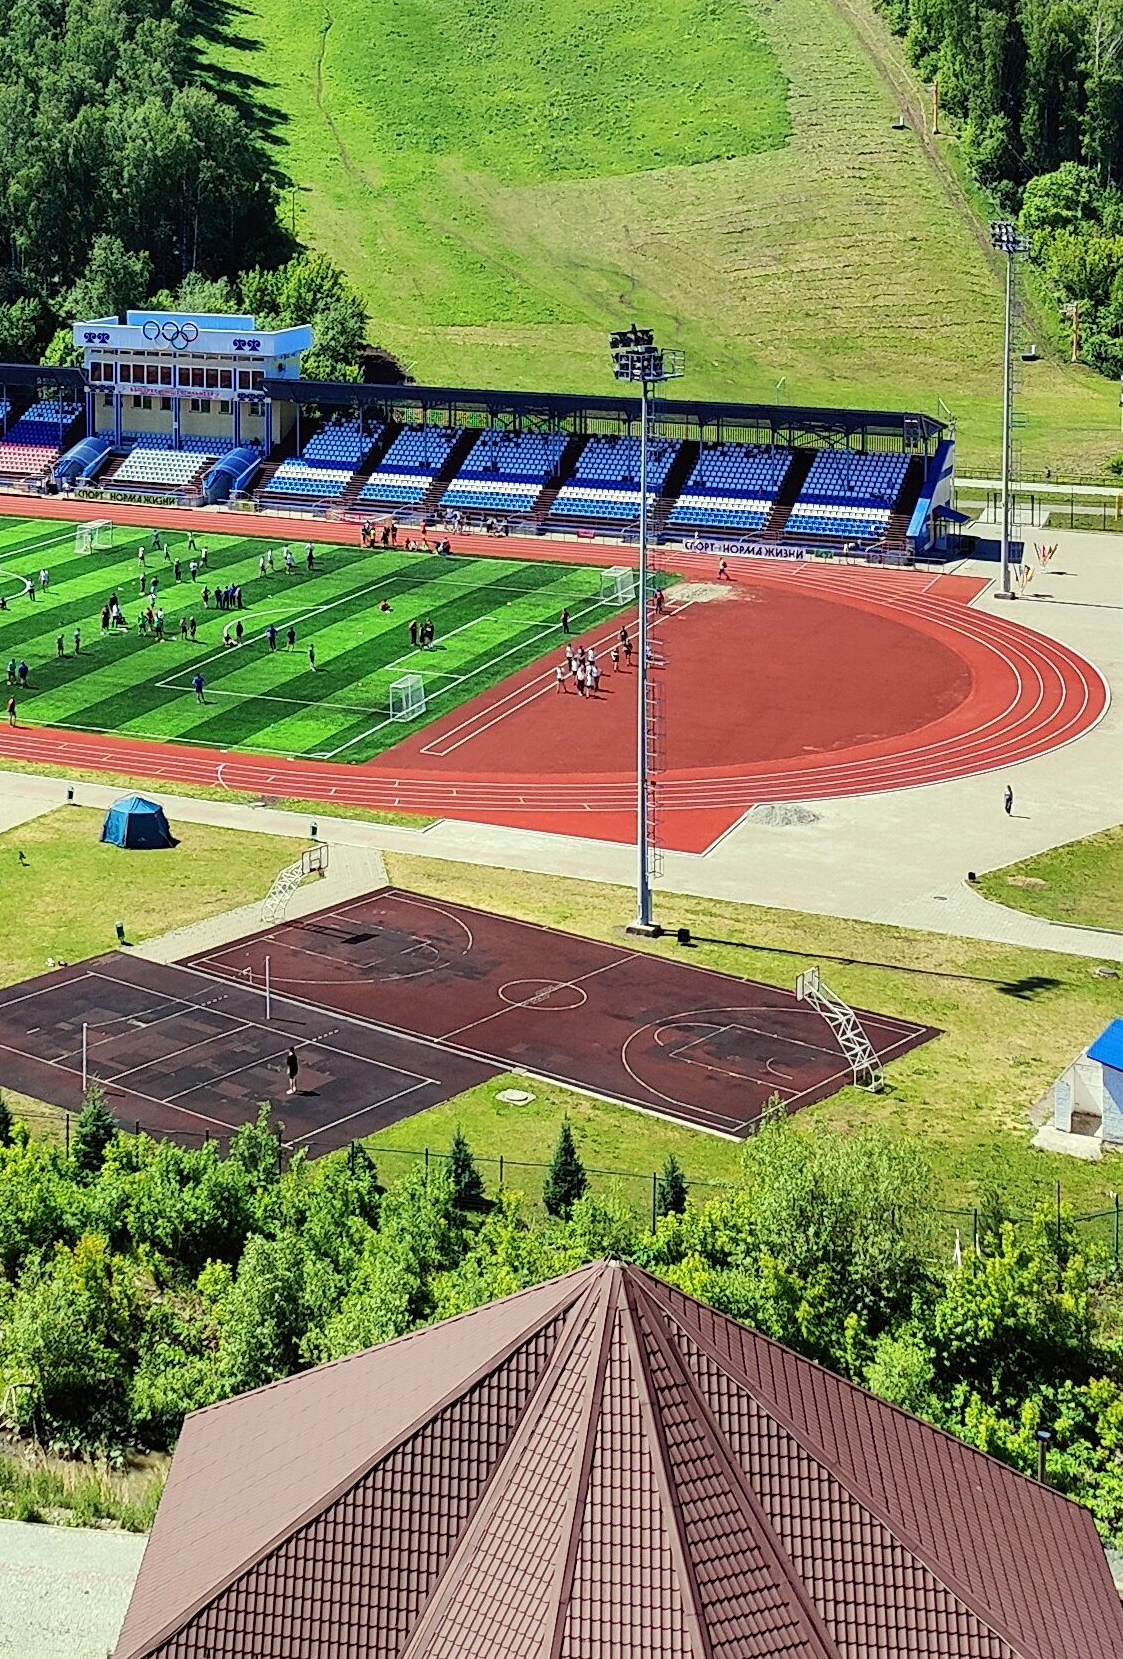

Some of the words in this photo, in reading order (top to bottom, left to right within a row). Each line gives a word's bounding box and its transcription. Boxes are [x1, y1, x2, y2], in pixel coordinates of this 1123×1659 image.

[77, 489, 104, 500] СПОРТ
[110, 492, 142, 504] НОРМА
[143, 495, 176, 506] ЖИЗНИ
[684, 541, 715, 552] СПОРТ
[723, 543, 763, 556] НОРМА
[764, 546, 804, 559] ЖИЗНИ
